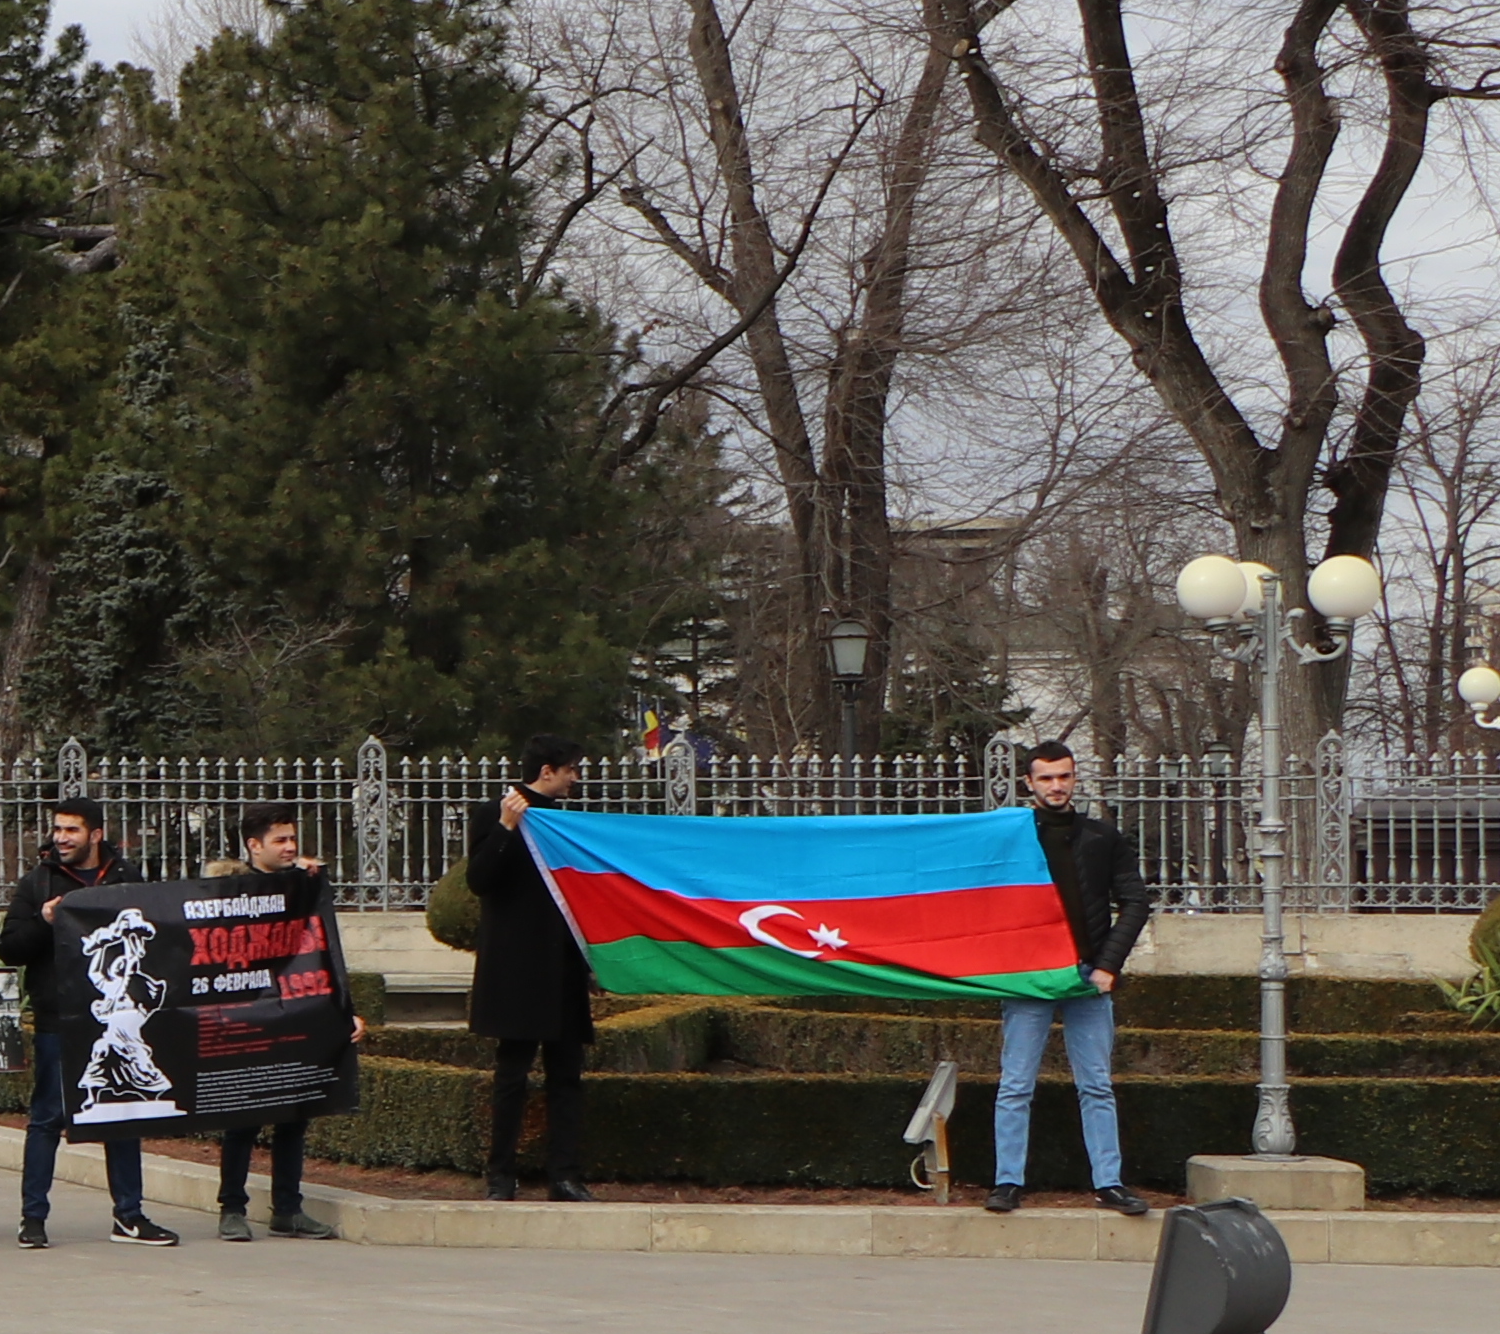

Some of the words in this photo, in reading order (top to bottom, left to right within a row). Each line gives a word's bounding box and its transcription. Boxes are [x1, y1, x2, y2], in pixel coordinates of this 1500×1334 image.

[183, 893, 286, 919] АЗЕРБАЙДЖАН
[188, 915, 327, 970] ХОДЖАЛЫ
[191, 976, 209, 995] 26
[277, 969, 333, 1000] 1992
